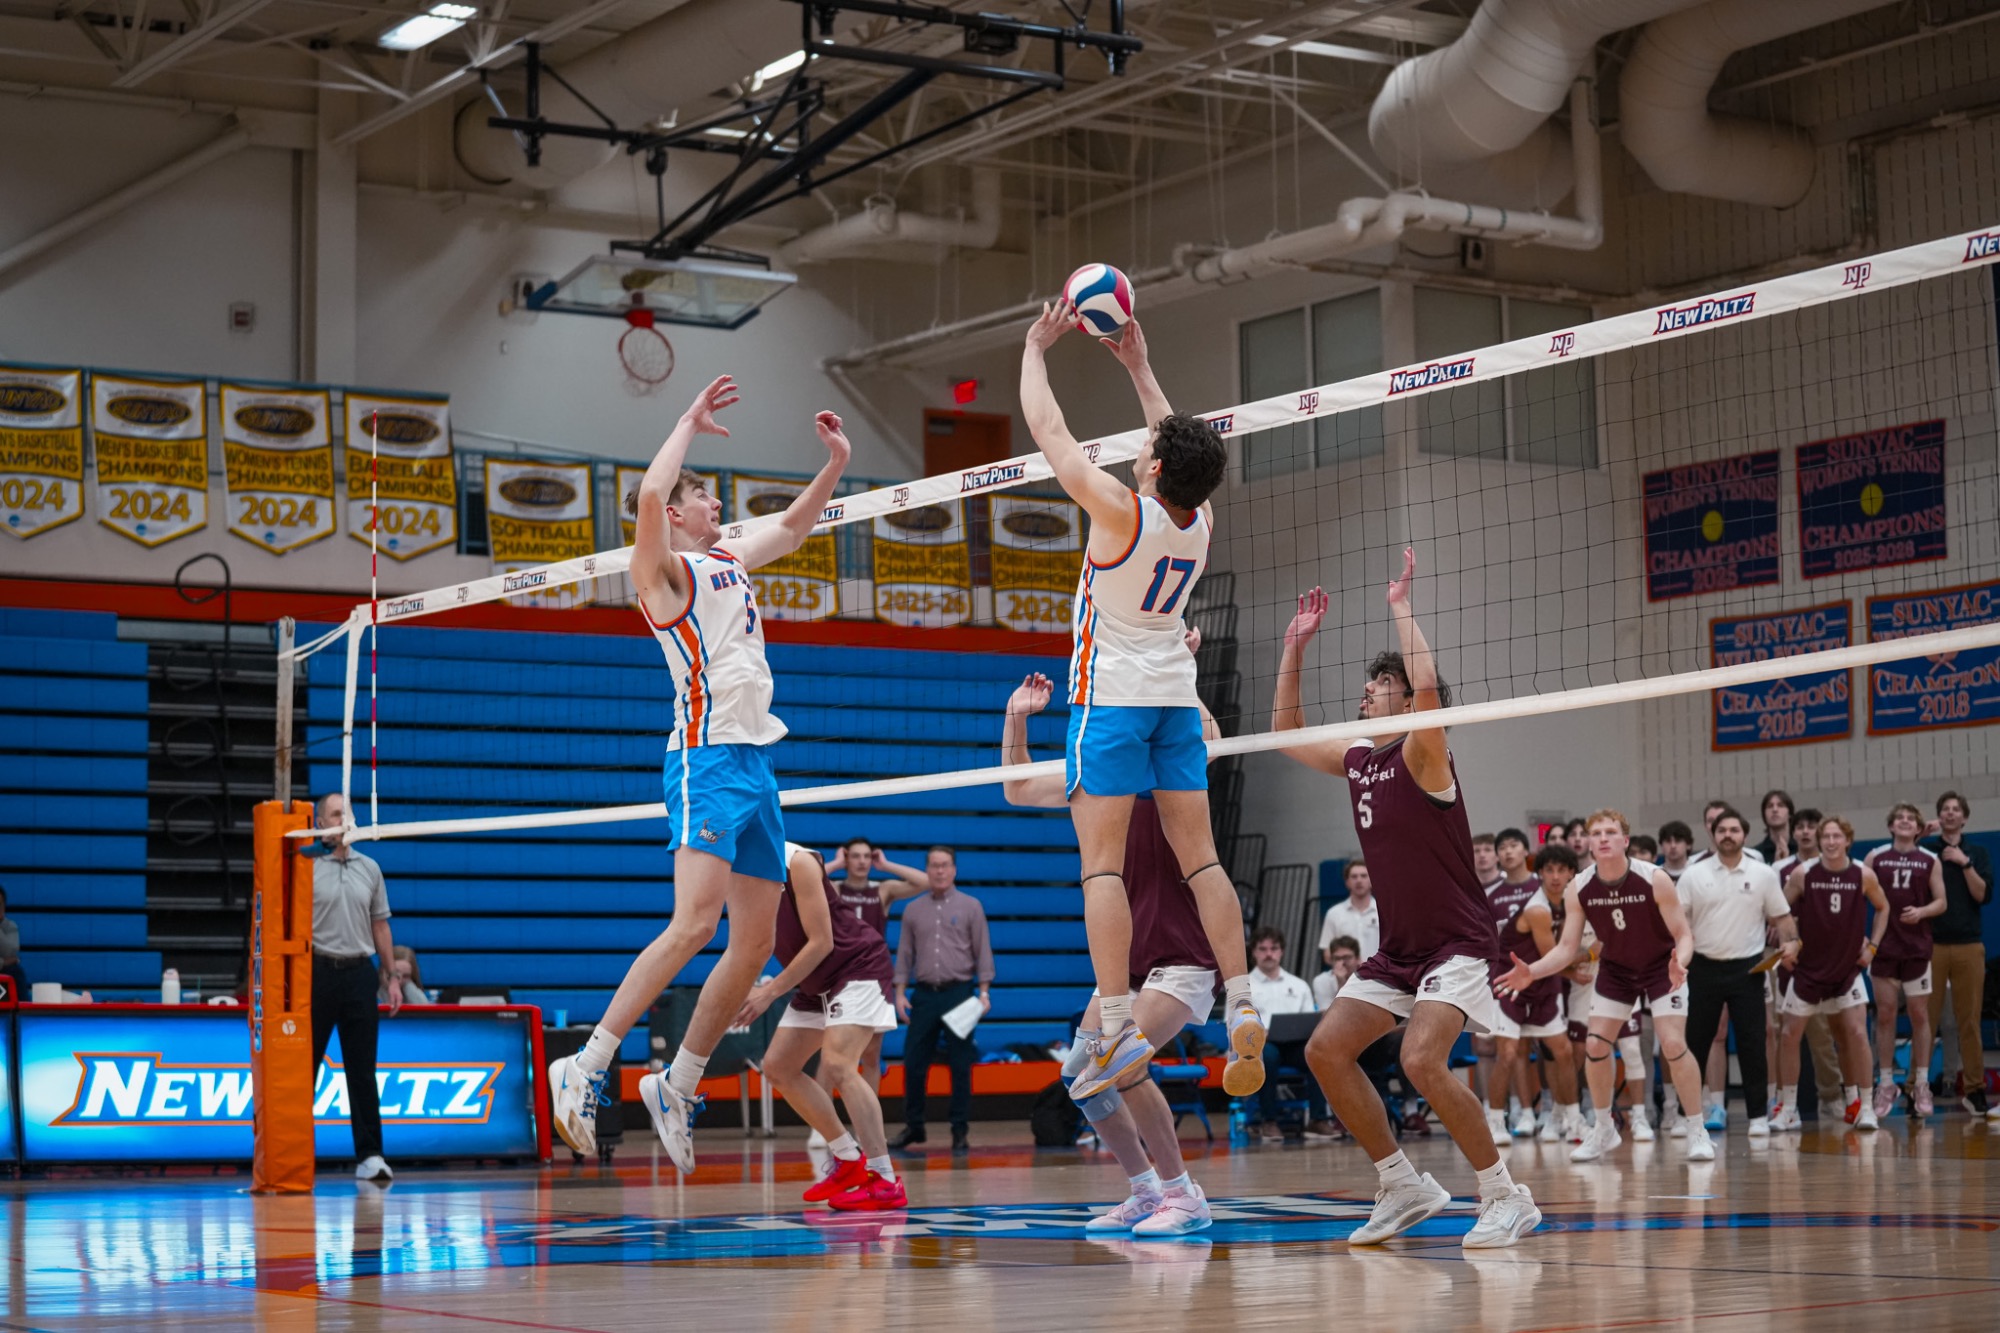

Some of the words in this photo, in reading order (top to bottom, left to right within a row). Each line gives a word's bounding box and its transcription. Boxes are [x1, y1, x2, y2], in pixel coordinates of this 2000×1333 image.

[1843, 262, 1871, 289] NP
[1549, 332, 1575, 357] NP
[1298, 392, 1319, 414] NP
[18, 433, 75, 451] BASKETBALL
[134, 442, 201, 462] BASKETBALL
[1827, 427, 1914, 462] SUNYAC
[0, 450, 79, 474] AMPIONS
[98, 460, 205, 482] CHAMPIONS
[285, 452, 328, 471] TENNIS
[351, 455, 449, 480] BASEBALL
[1671, 457, 1752, 490] SUNYAC
[1801, 456, 1876, 496] WOMEN'S
[1880, 447, 1942, 475] TENNIS
[226, 468, 330, 491] CHAMPIONS
[350, 477, 453, 499] CHAMPIONS
[0, 478, 66, 512] 024
[109, 488, 191, 522] 2024
[893, 487, 909, 506] NP
[1646, 485, 1718, 521] WOMEN'S
[1722, 473, 1778, 503] TENNIS
[239, 496, 318, 528] 2024
[363, 505, 441, 537] 2024
[491, 519, 591, 541] SOFTBALL
[1803, 504, 1947, 551] CHAMPIONS
[492, 540, 592, 556] CHAMPIONS
[1650, 533, 1779, 574] CHAMPIONS
[709, 569, 739, 592] NEW
[1140, 555, 1197, 614] 17
[1691, 563, 1738, 591] 2025
[754, 578, 822, 611] 2025
[1006, 593, 1074, 624] 2026
[1892, 590, 1992, 627] SUNYAC
[1734, 611, 1827, 649] SUNYAC
[1873, 657, 2000, 698] CHAMPION
[1717, 672, 1849, 716] CHAMPIONS
[1918, 690, 1970, 723] 2018
[1758, 709, 1806, 740] 2018
[1357, 792, 1373, 829] 5
[1811, 881, 1858, 891] SPRINGFIEL
[1892, 869, 1912, 889] 17
[1830, 892, 1842, 914] 9
[1611, 908, 1627, 930] 8
